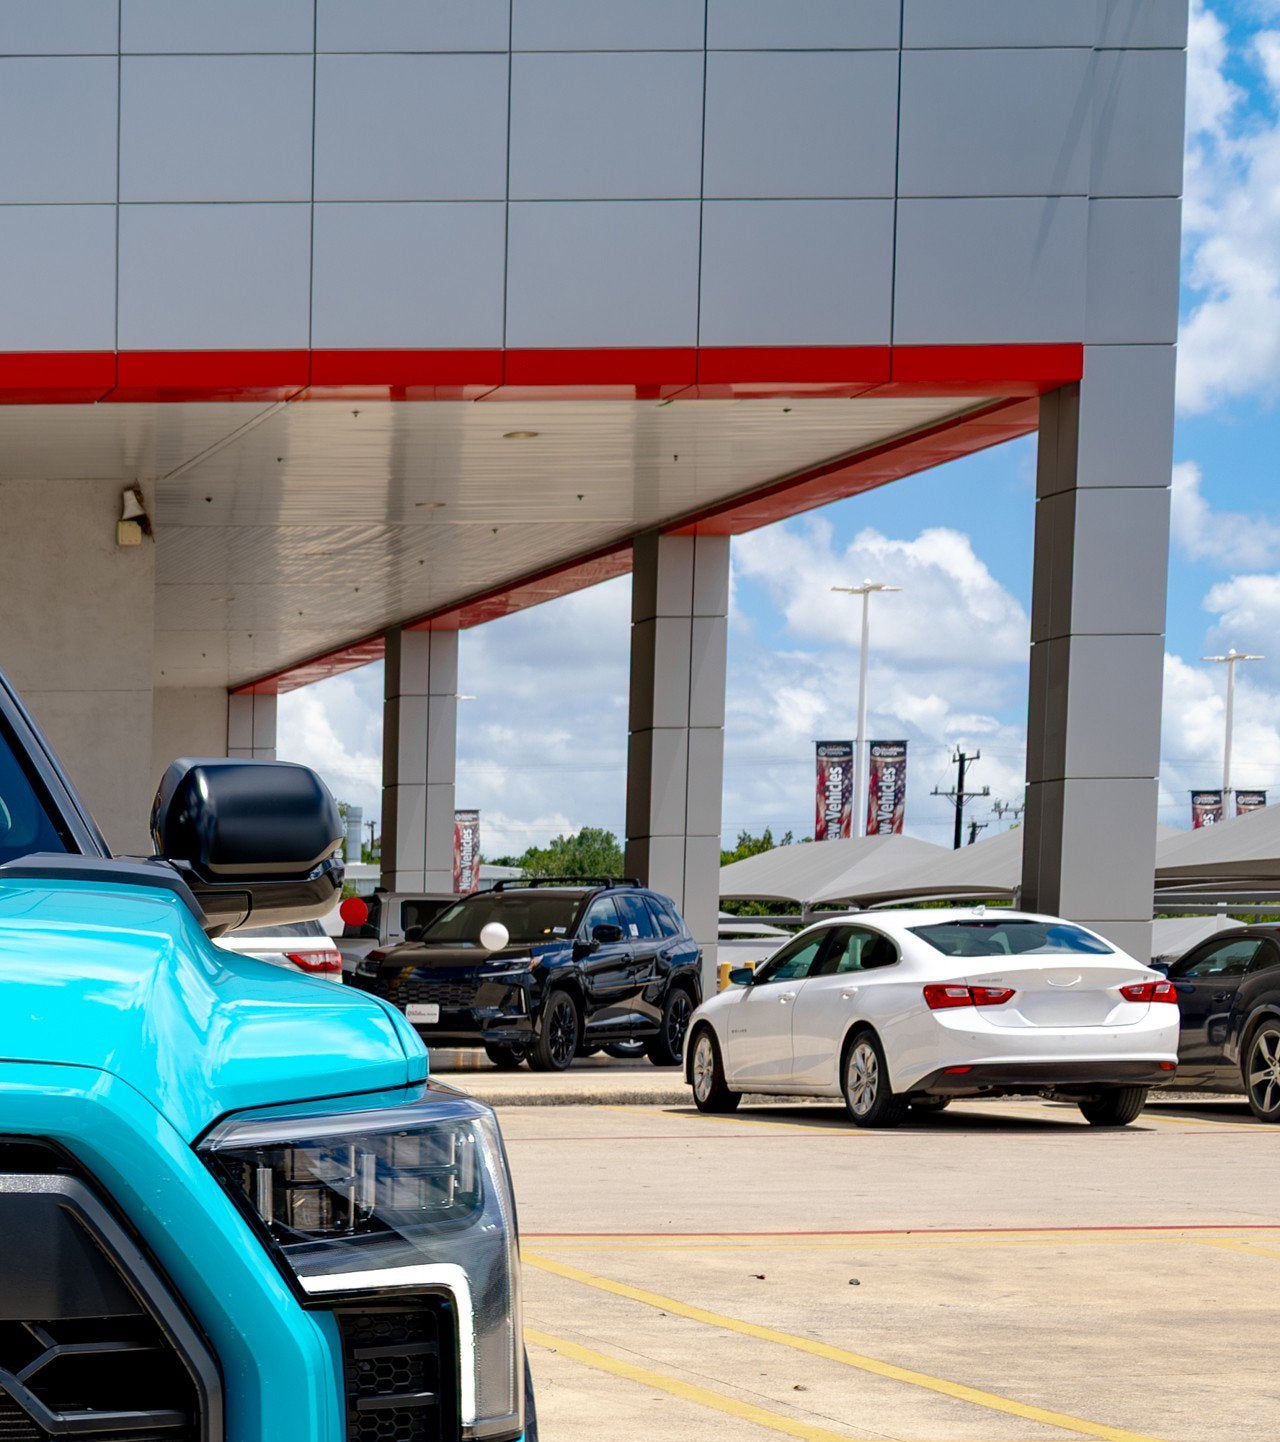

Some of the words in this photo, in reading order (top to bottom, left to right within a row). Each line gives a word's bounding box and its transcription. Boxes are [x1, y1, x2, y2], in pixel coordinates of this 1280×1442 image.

[825, 766, 842, 820] Vehicles
[877, 766, 896, 821] Vehicles
[460, 828, 473, 868] Vehicles
